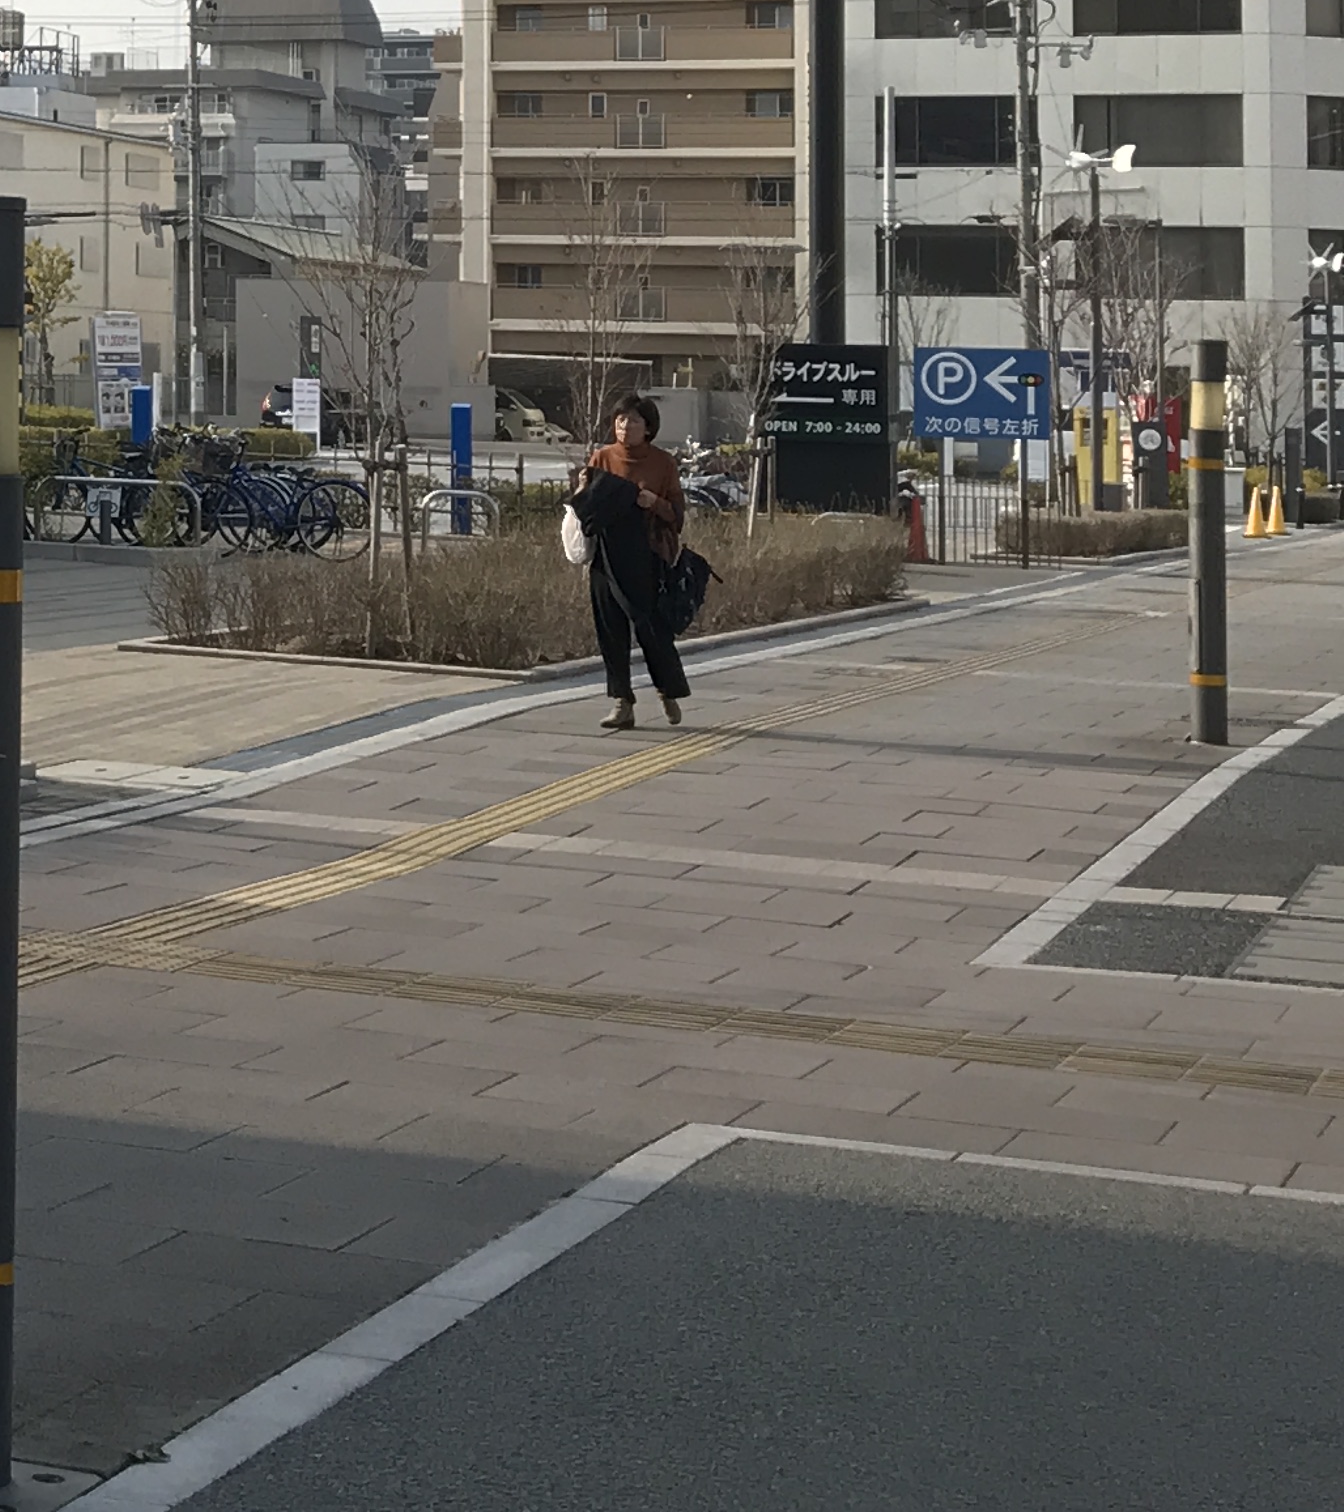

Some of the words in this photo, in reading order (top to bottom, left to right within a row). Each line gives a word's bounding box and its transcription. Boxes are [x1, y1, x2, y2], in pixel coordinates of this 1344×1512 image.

[841, 389, 877, 406] 専用
[764, 420, 798, 432] OPEN
[804, 421, 833, 433] 7:00
[844, 422, 882, 434] 24:00
[924, 416, 1040, 436] 次の信号左折
